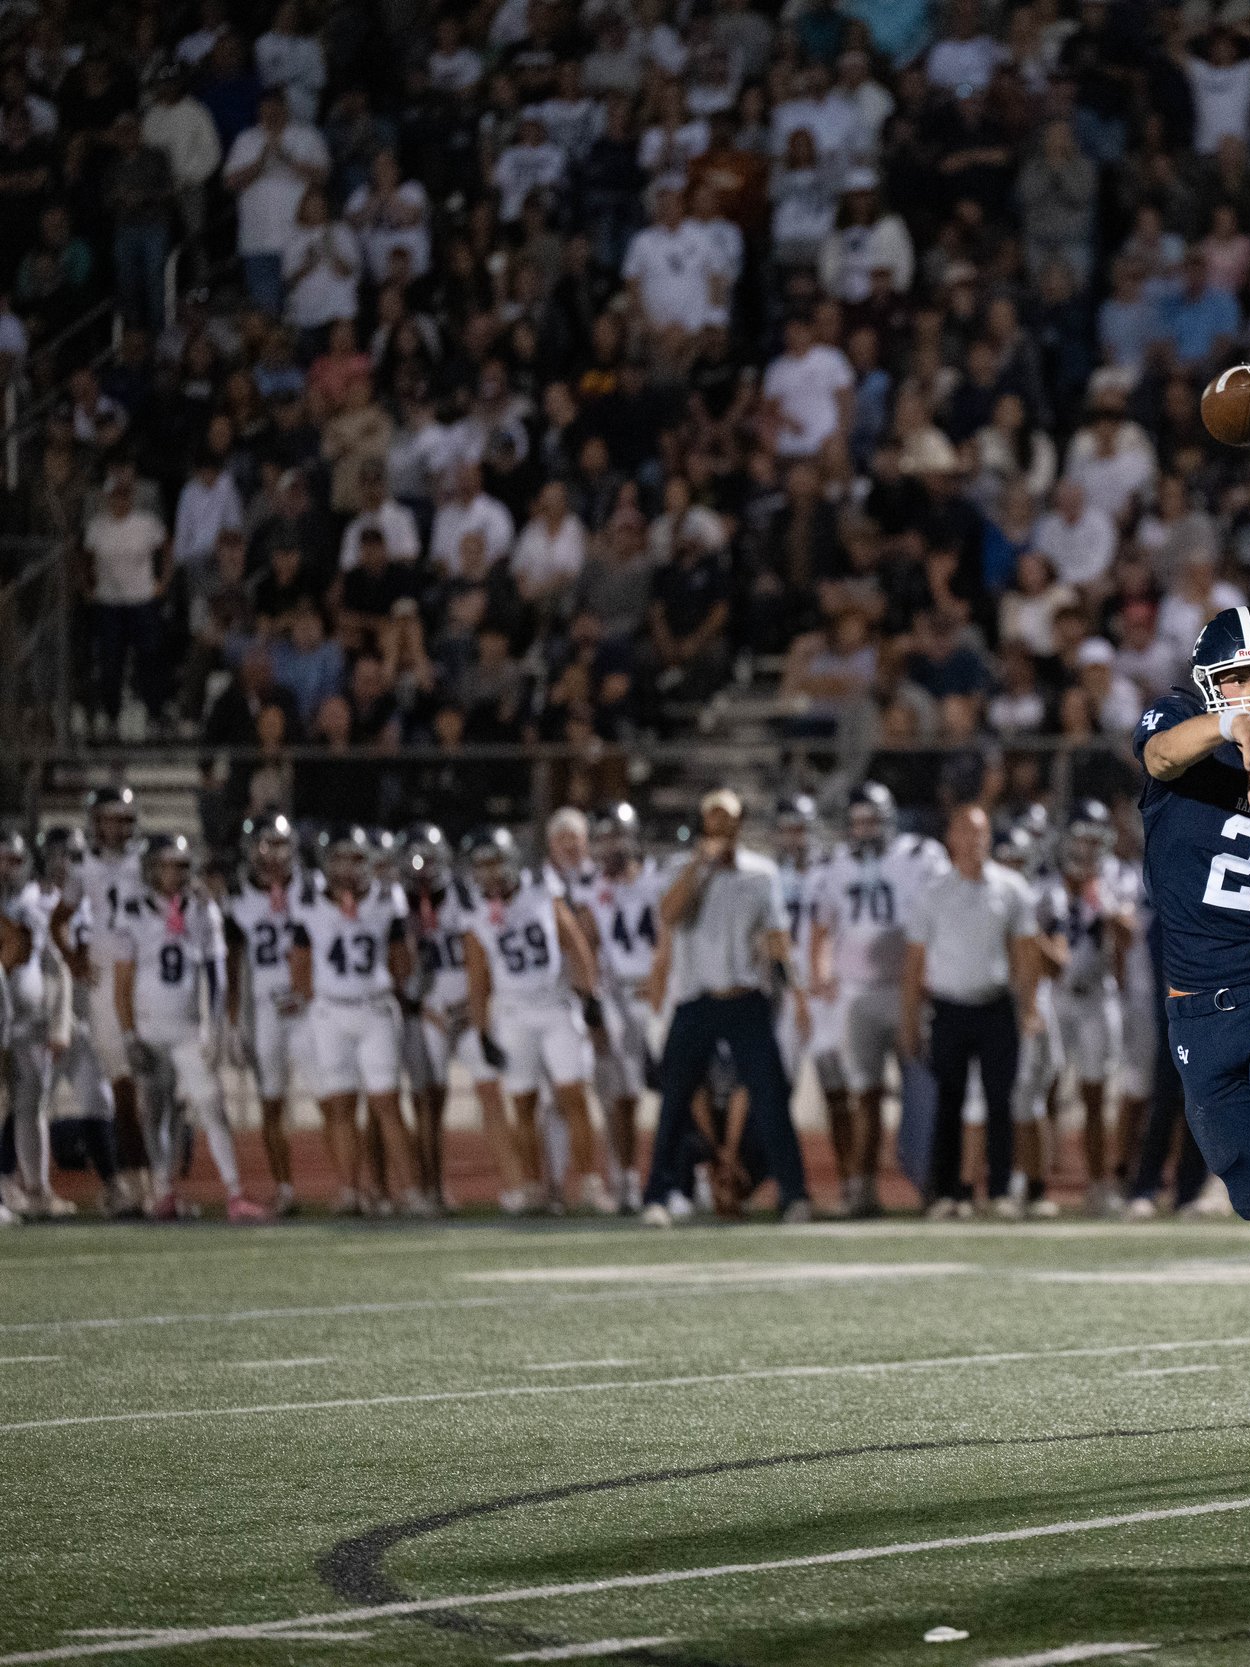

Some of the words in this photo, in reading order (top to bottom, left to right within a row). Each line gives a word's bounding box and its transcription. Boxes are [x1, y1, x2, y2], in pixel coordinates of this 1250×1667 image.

[845, 878, 895, 924] 70
[499, 921, 549, 973] 59
[611, 905, 657, 953] 44
[328, 934, 377, 976] 43
